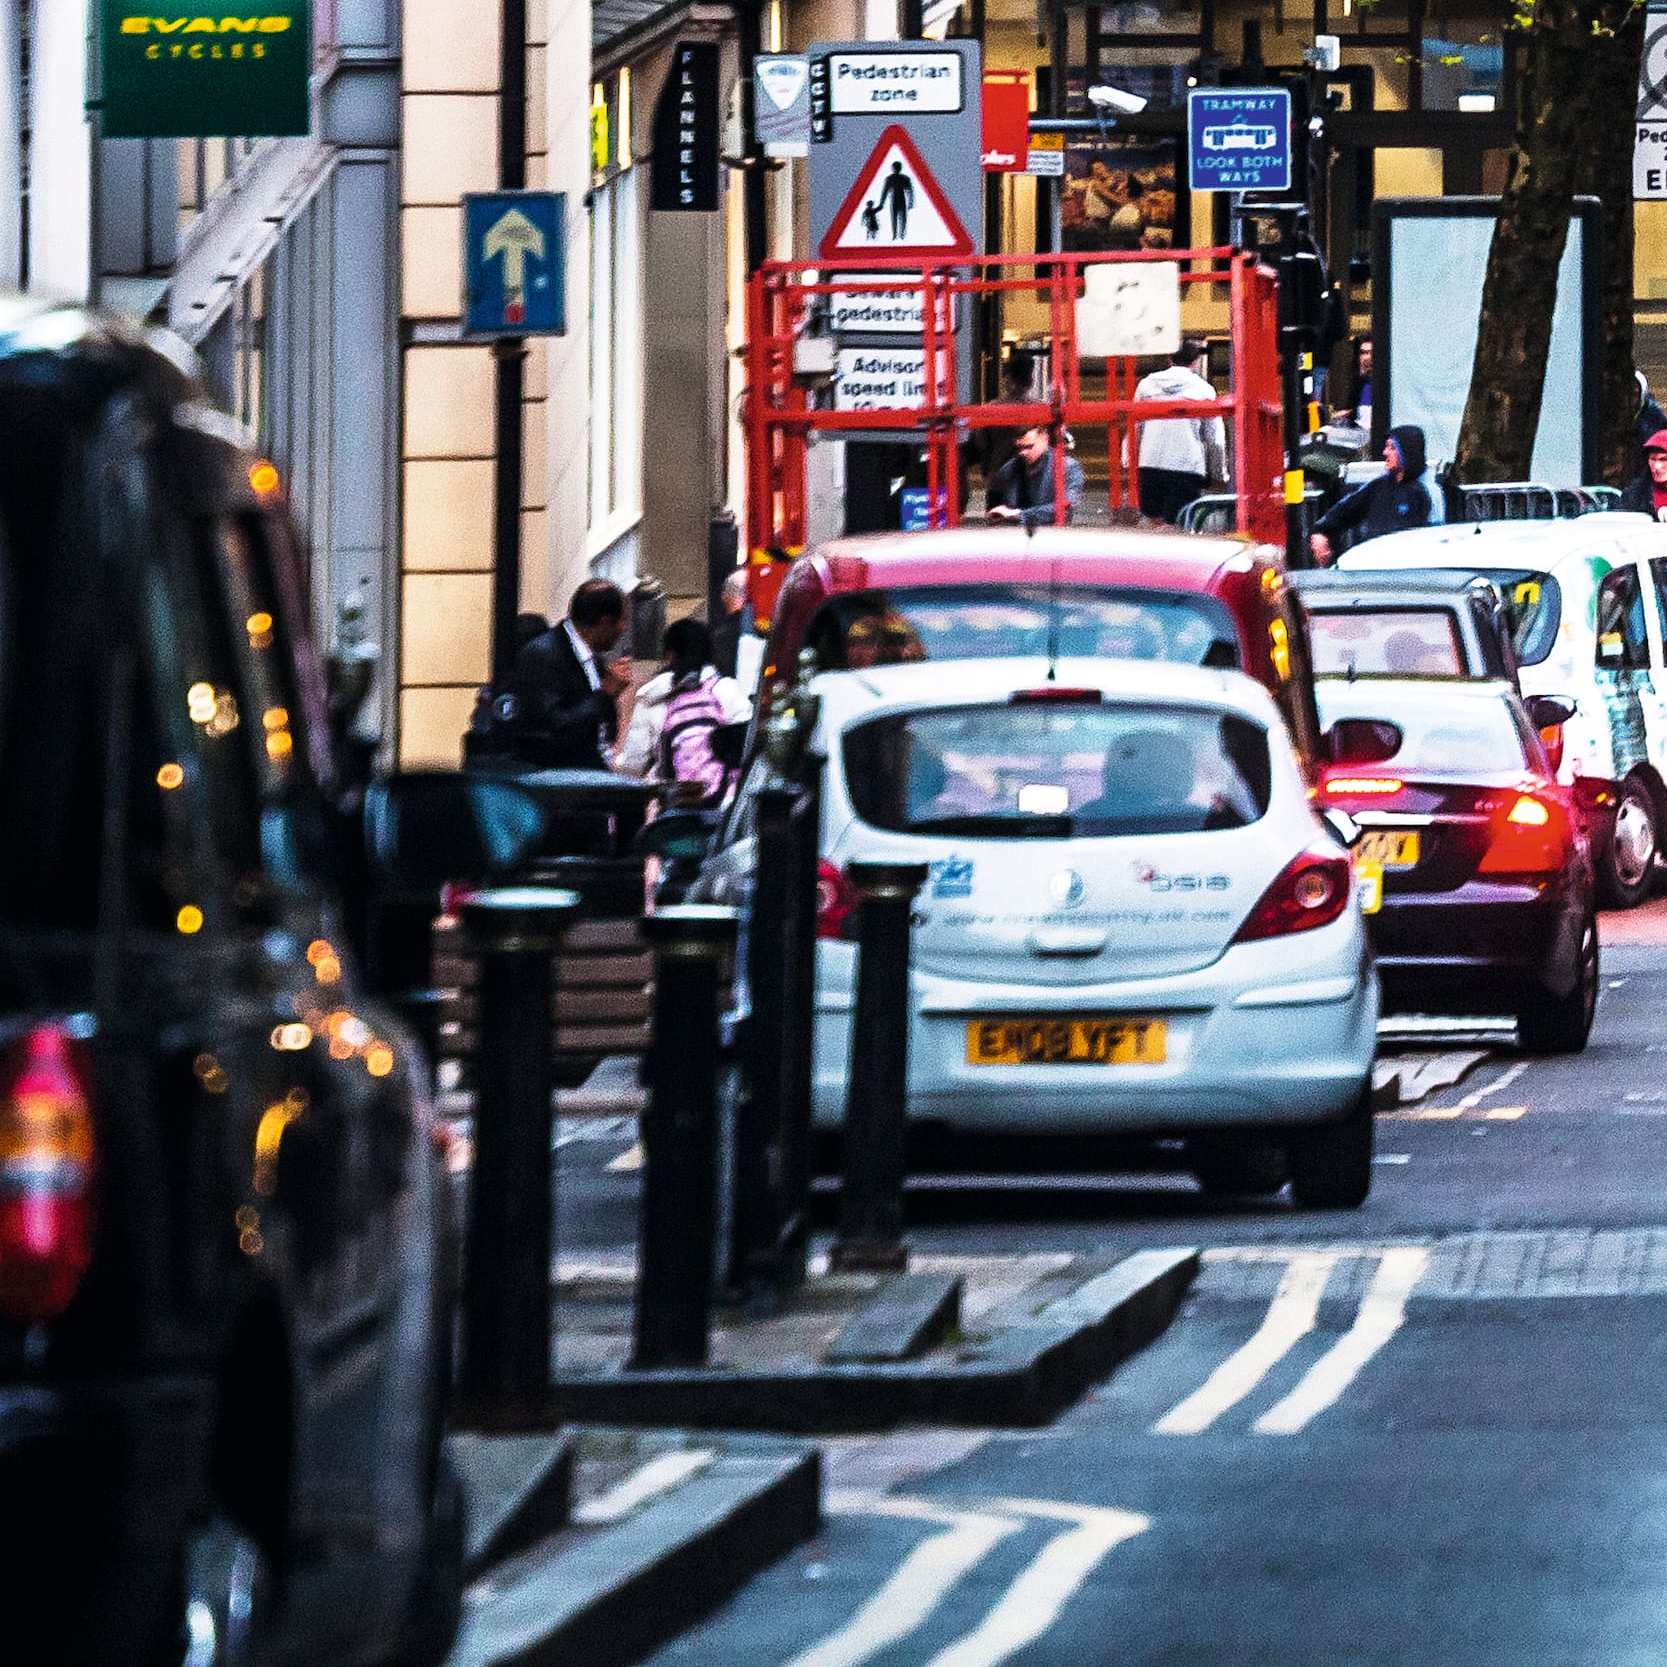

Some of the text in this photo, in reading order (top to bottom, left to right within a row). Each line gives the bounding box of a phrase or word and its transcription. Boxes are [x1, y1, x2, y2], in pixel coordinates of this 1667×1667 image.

[120, 16, 292, 34] EVANS
[145, 43, 266, 60] CYCLES
[838, 62, 951, 80] Pedestrian
[869, 88, 918, 102] zone
[1202, 99, 1277, 111] TRAMWAY
[679, 50, 697, 204] FLANNELS
[1197, 156, 1283, 169] LOOK BOTH
[1218, 170, 1261, 183] WAYS
[852, 356, 925, 374] Advisor
[841, 380, 896, 397] speed
